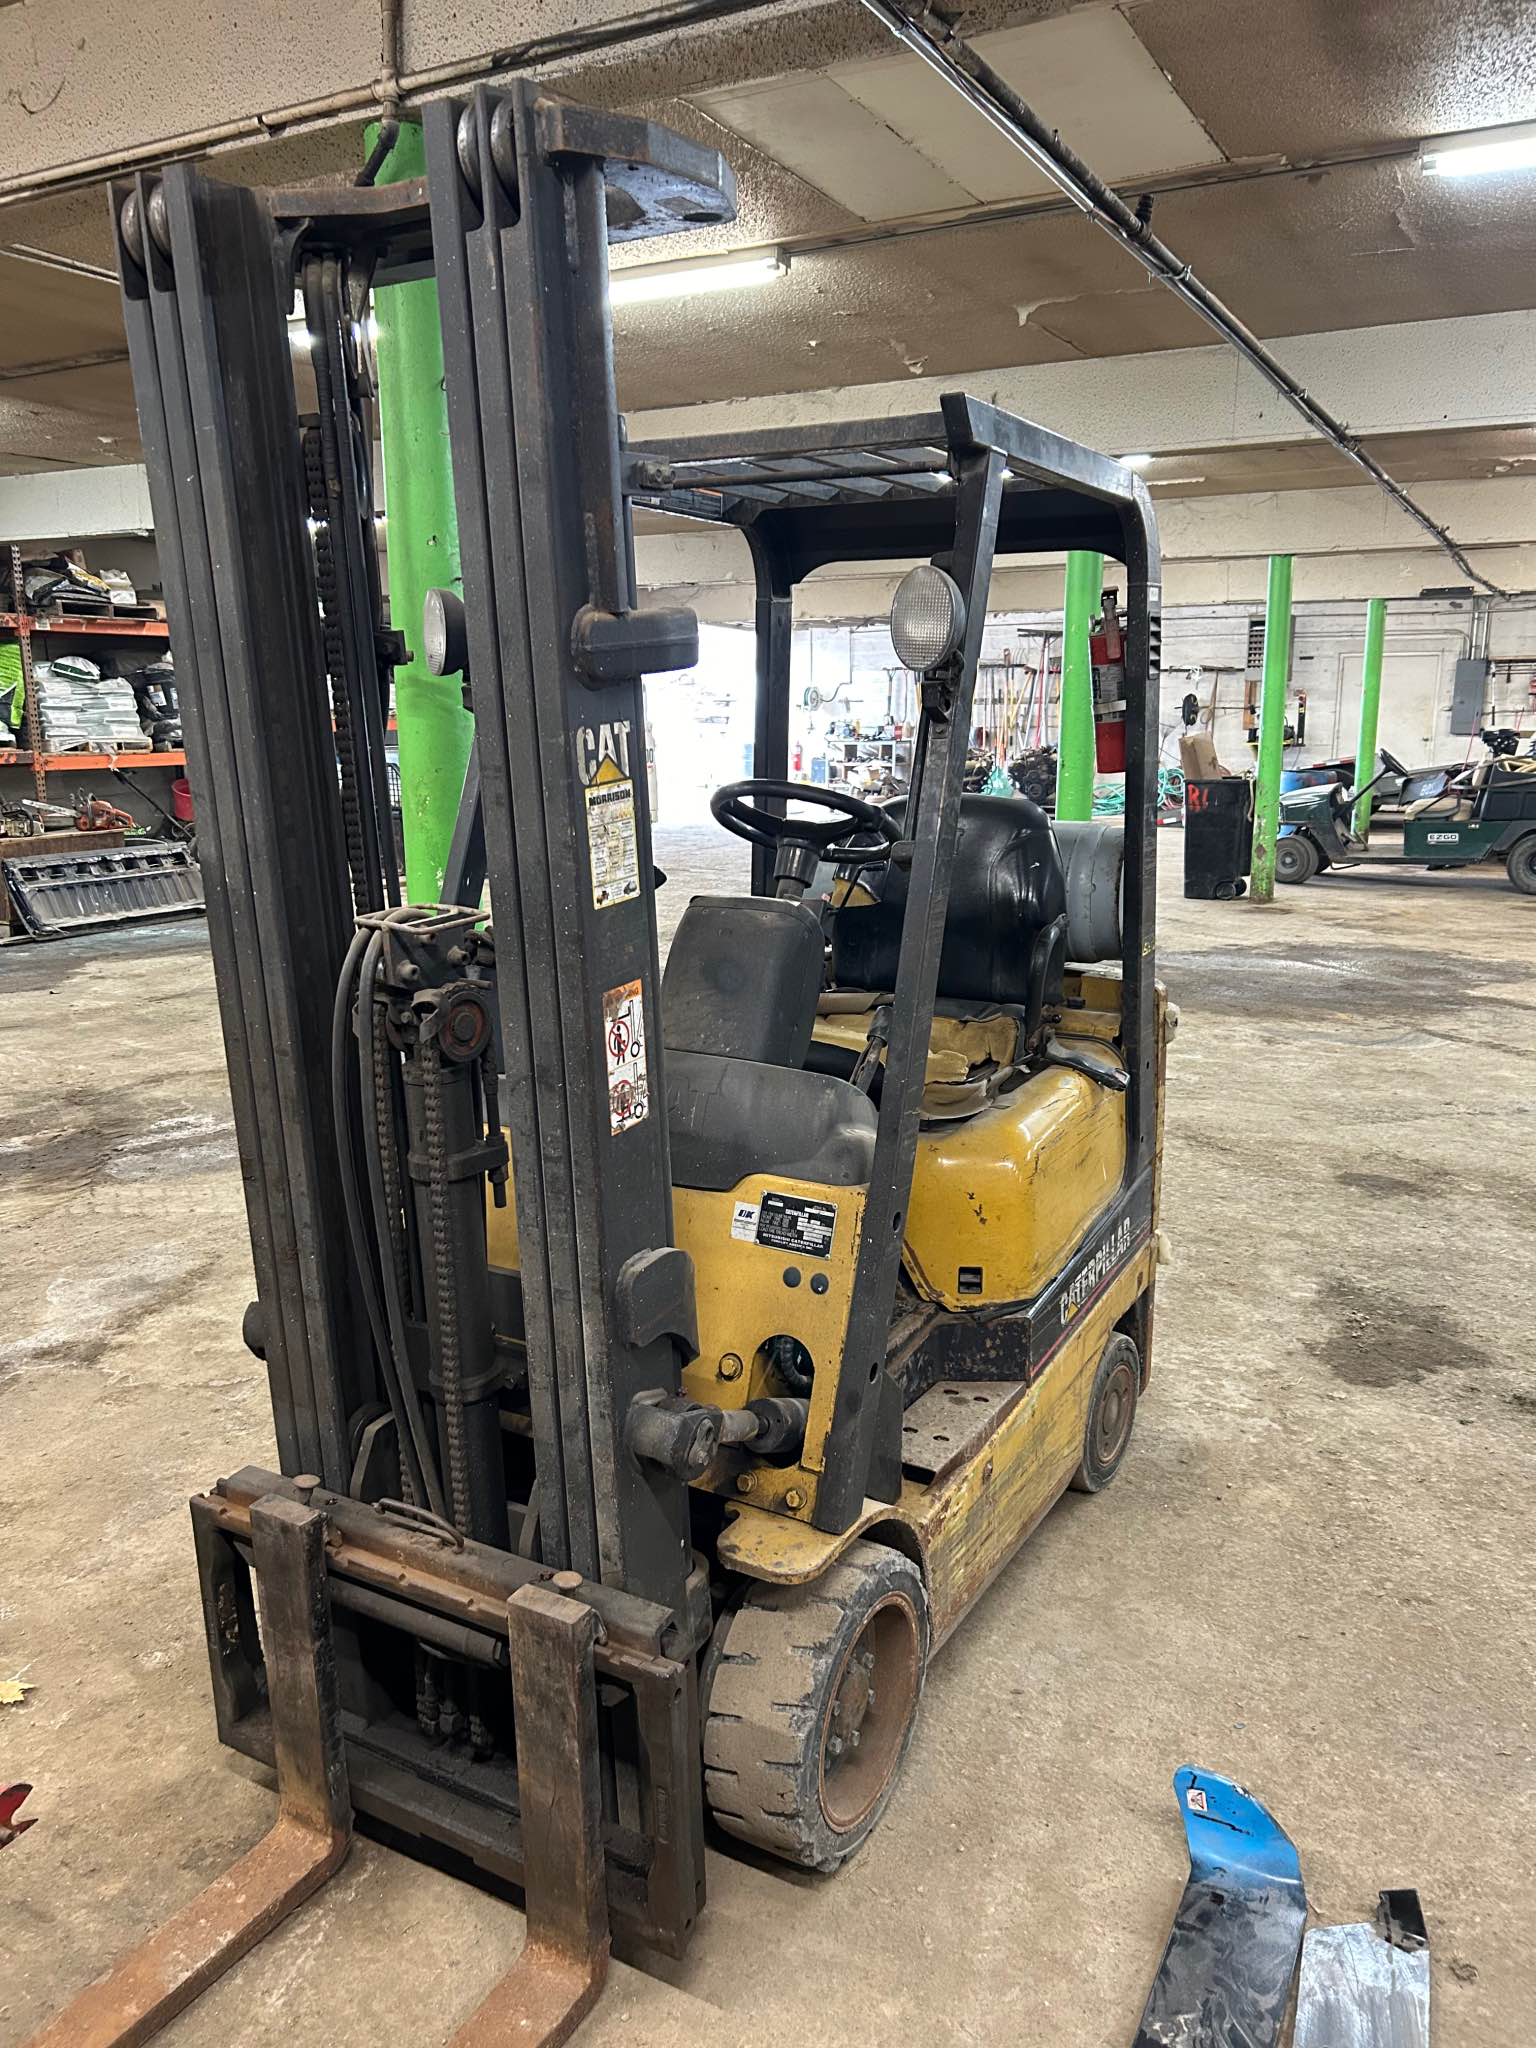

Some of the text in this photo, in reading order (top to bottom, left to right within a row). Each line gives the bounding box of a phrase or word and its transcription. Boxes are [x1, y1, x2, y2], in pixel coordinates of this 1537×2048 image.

[576, 720, 631, 785] CAT
[588, 789, 631, 805] MORRISON
[1059, 1216, 1131, 1326] CATERPILLAR
